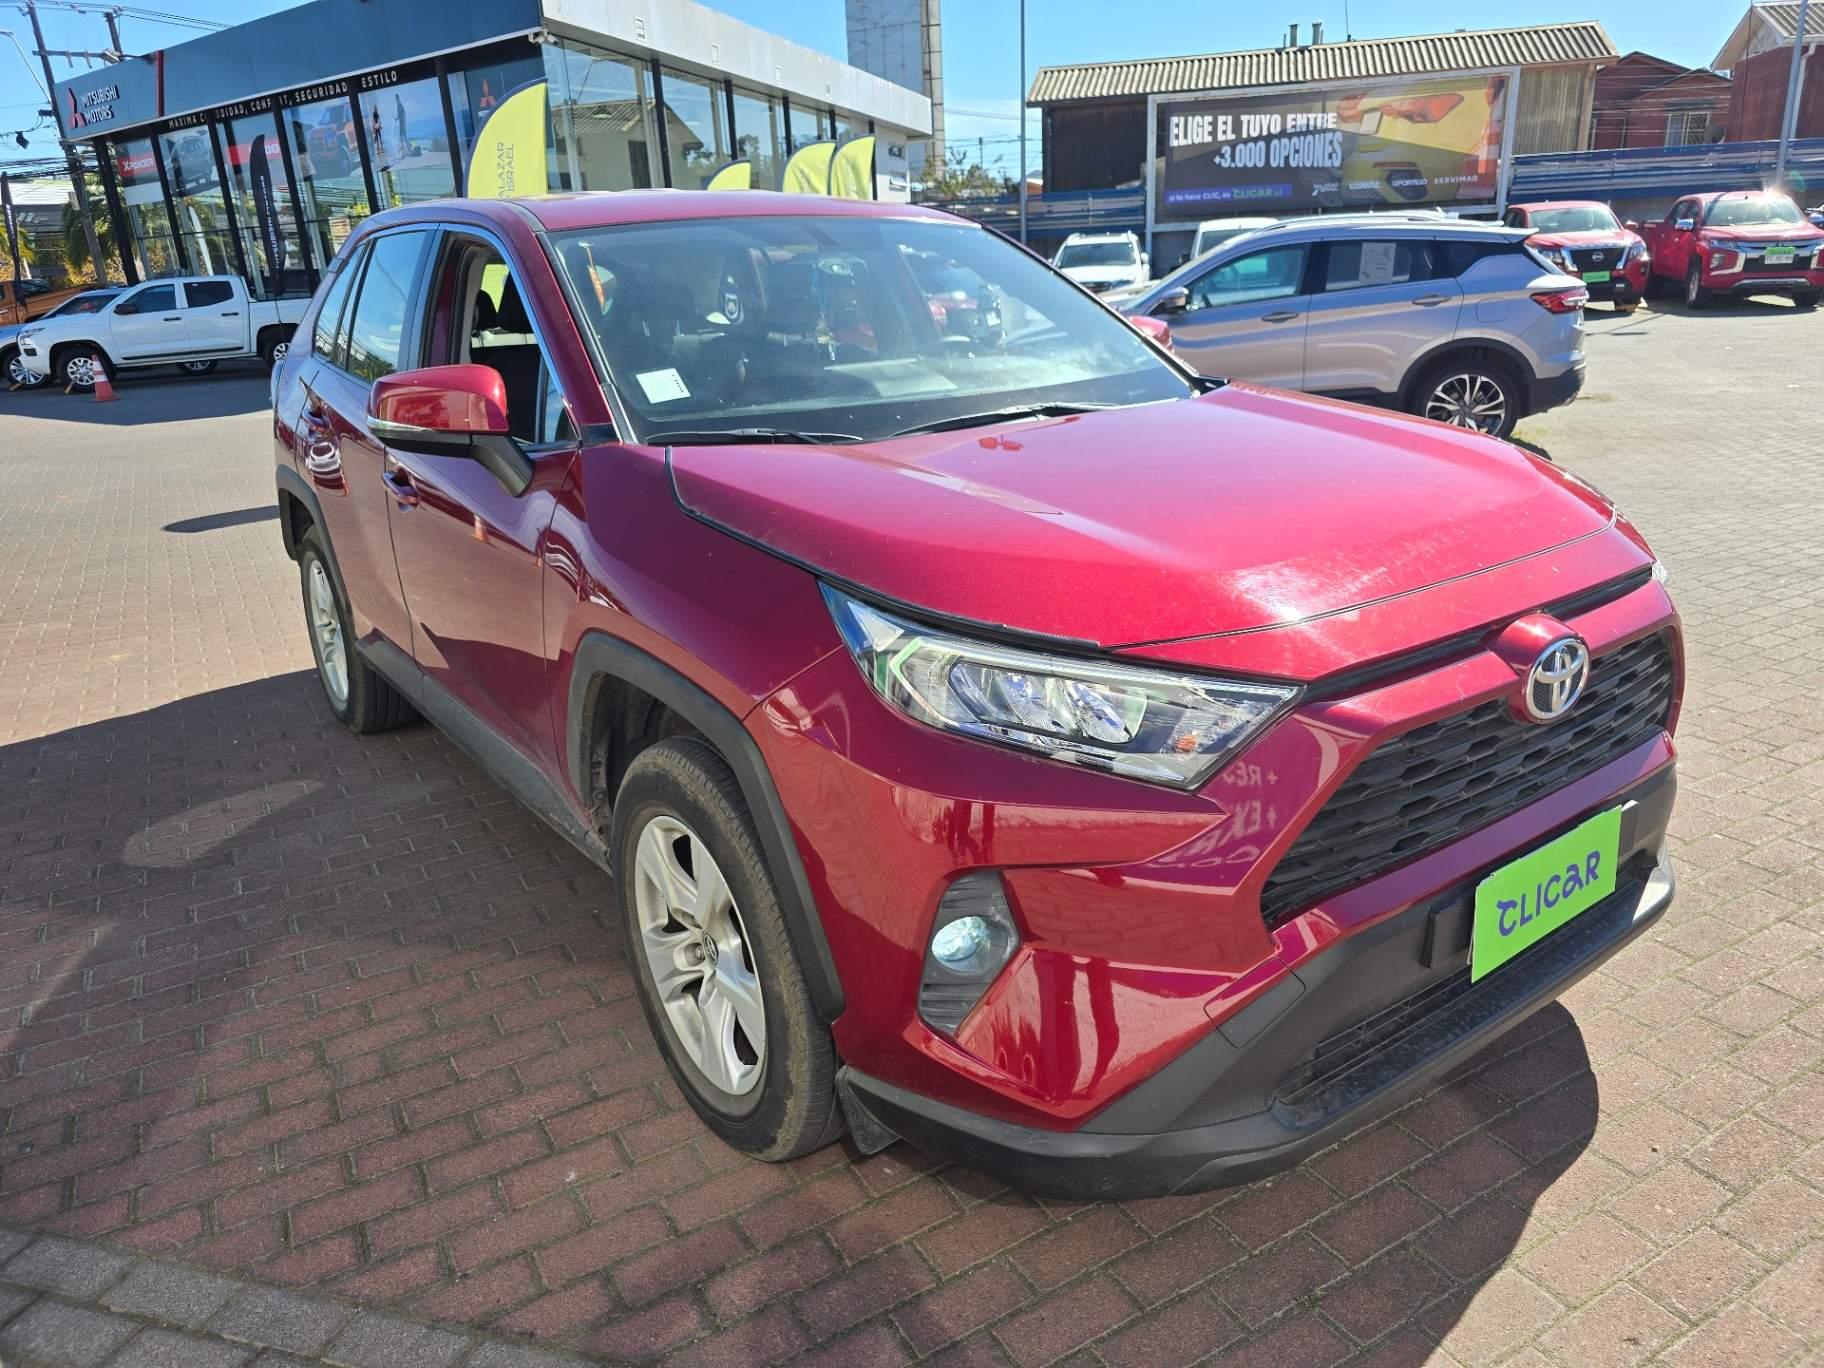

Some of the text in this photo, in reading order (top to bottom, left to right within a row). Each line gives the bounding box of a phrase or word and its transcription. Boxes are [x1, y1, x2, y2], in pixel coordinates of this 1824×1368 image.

[81, 85, 120, 108] MITSUBISHI
[295, 82, 348, 103] SEGURIDAD
[361, 70, 398, 88] ESTILO
[84, 105, 114, 125] MOTORS
[1169, 112, 1337, 147] ELIGE EL TUYO ENTRE
[1213, 131, 1343, 168] +3.000 OPCIONES
[506, 143, 515, 191] ISRAEL
[1433, 175, 1478, 185] SERVIMAQ
[1496, 850, 1601, 937] CLICAR
